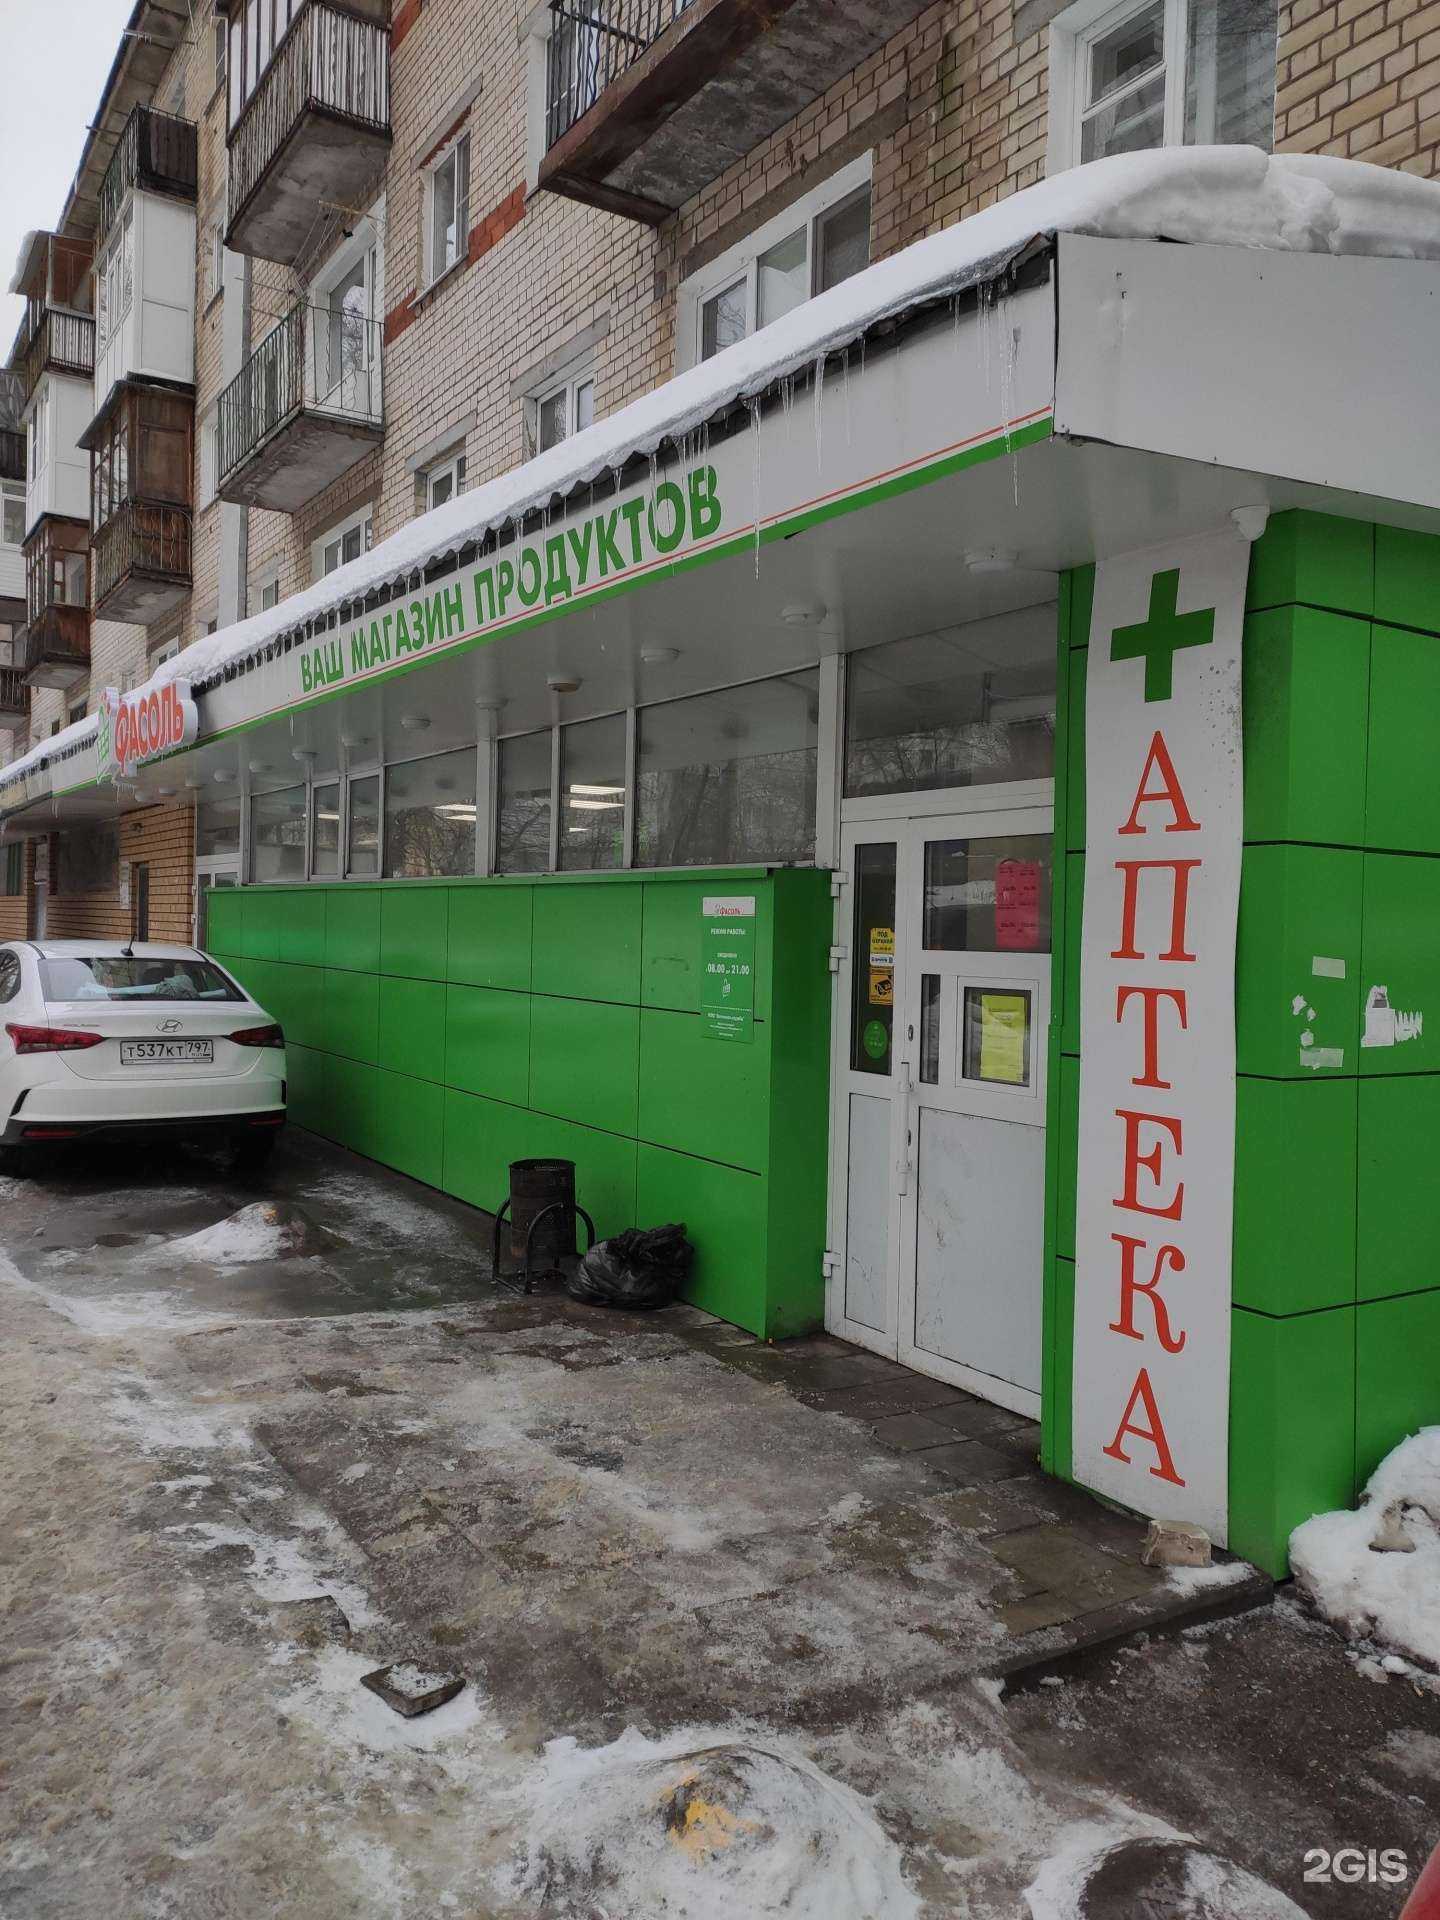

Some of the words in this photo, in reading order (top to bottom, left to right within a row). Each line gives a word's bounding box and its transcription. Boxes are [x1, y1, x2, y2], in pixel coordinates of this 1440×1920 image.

[301, 638, 344, 693] ВАШ
[350, 582, 465, 674] МАГАЗИН
[473, 464, 722, 625] ПРОДУКТОВ
[115, 681, 185, 769] ФАСОЛЬ
[1102, 730, 1203, 1488] АПТЕКА
